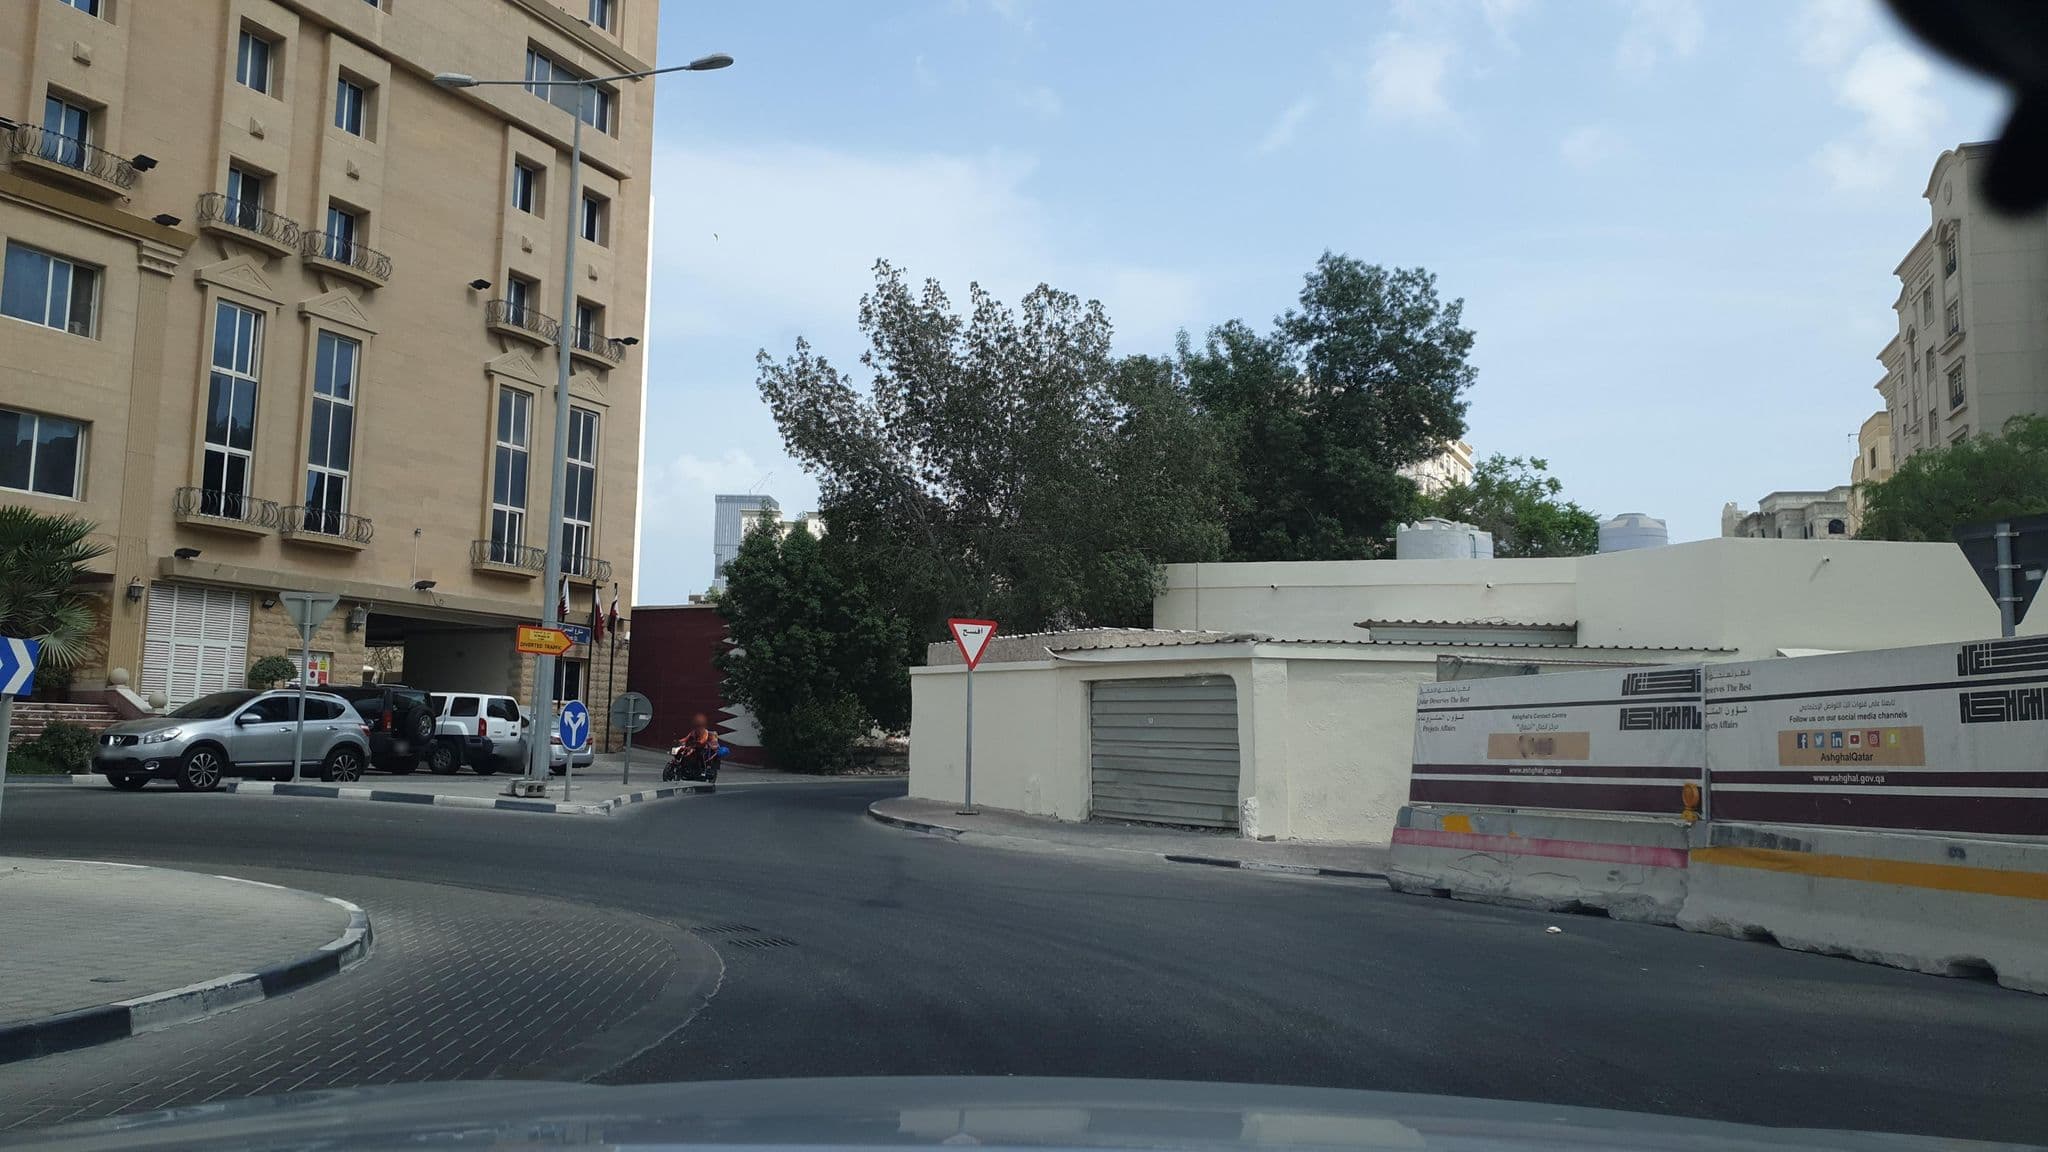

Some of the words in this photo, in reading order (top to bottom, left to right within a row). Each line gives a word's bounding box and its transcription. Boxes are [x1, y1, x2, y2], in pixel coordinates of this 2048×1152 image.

[544, 643, 562, 651] TRAFFIC
[1620, 706, 1702, 730] ASHGHAL
[1790, 715, 1808, 723] Follow
[1857, 712, 1877, 720] media
[1878, 710, 1908, 719] channels
[1820, 751, 1874, 764] AshghalQatar
[1509, 767, 1562, 776] www.ashghal.gov.qa
[1813, 773, 1885, 785] www.ashghal.gov.qa
